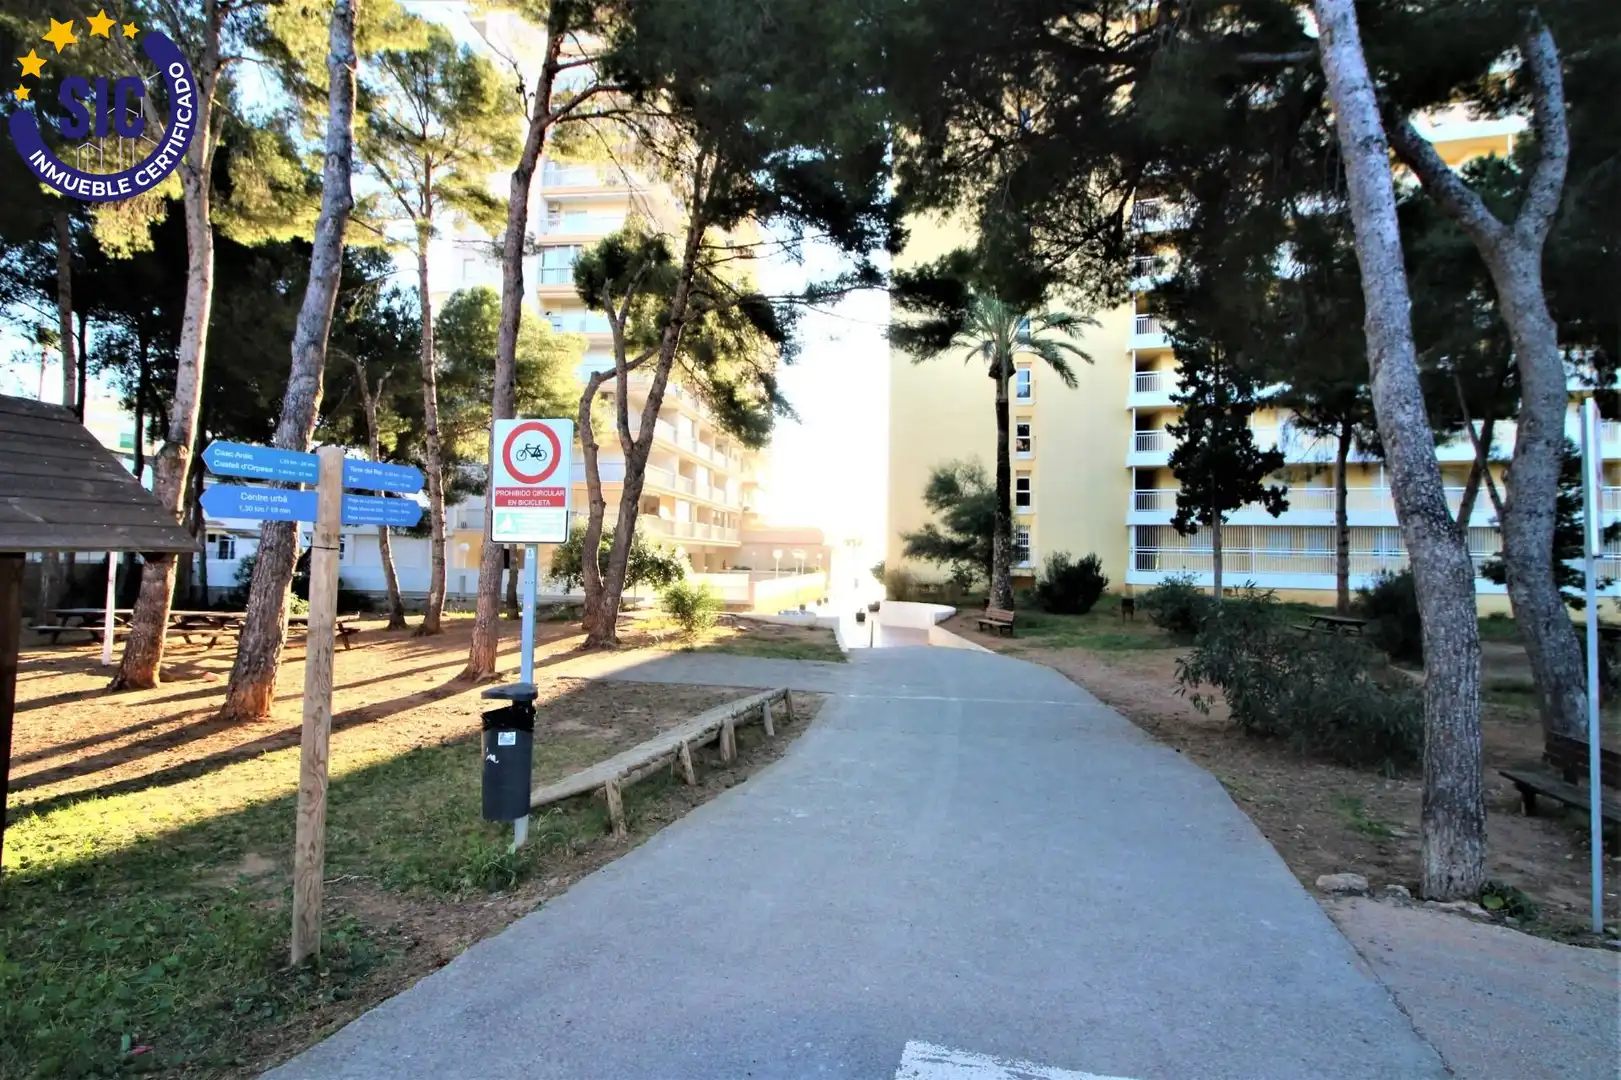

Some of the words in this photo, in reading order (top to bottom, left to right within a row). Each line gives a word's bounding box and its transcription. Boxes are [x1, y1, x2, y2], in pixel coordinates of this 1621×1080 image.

[240, 492, 268, 502] Centre
[496, 489, 531, 497] PROHIBIDO
[532, 489, 565, 497] CIRCULAR
